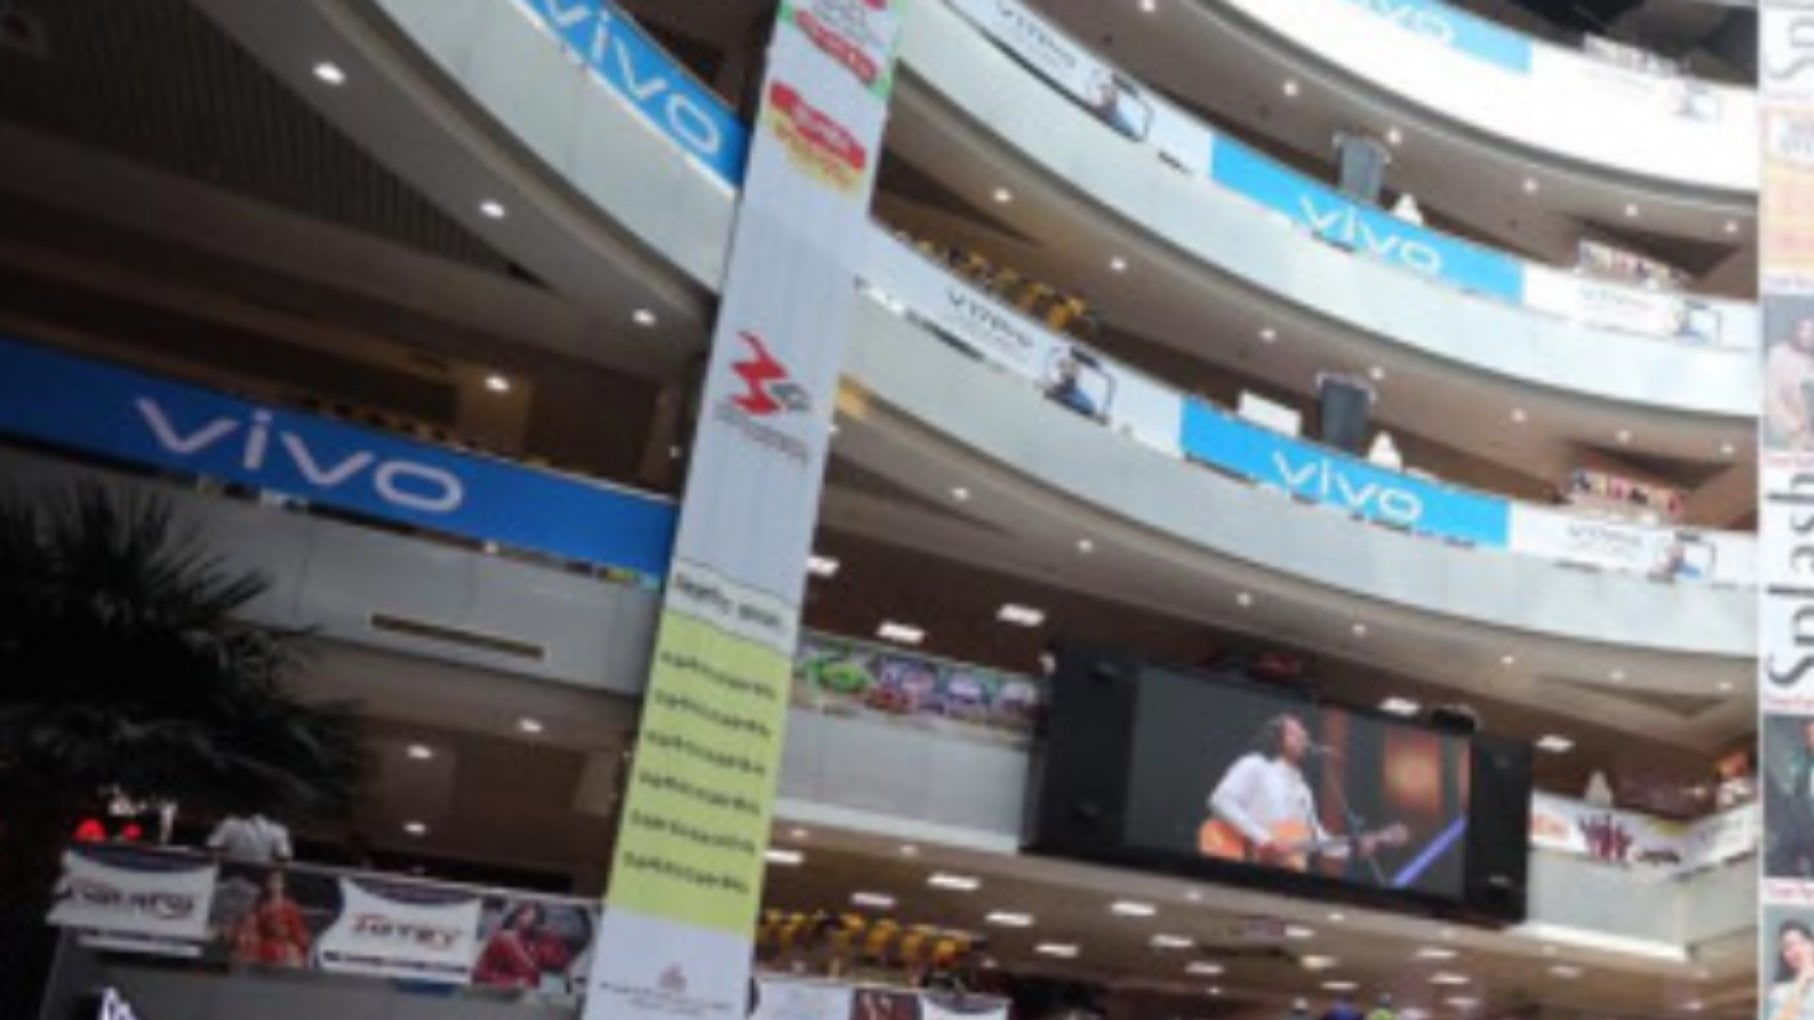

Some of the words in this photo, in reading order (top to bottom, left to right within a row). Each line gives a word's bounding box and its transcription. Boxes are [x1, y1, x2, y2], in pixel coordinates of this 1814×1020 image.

[1300, 194, 1442, 276] vivo
[134, 397, 465, 513] vivo
[1272, 450, 1423, 520] vivo
